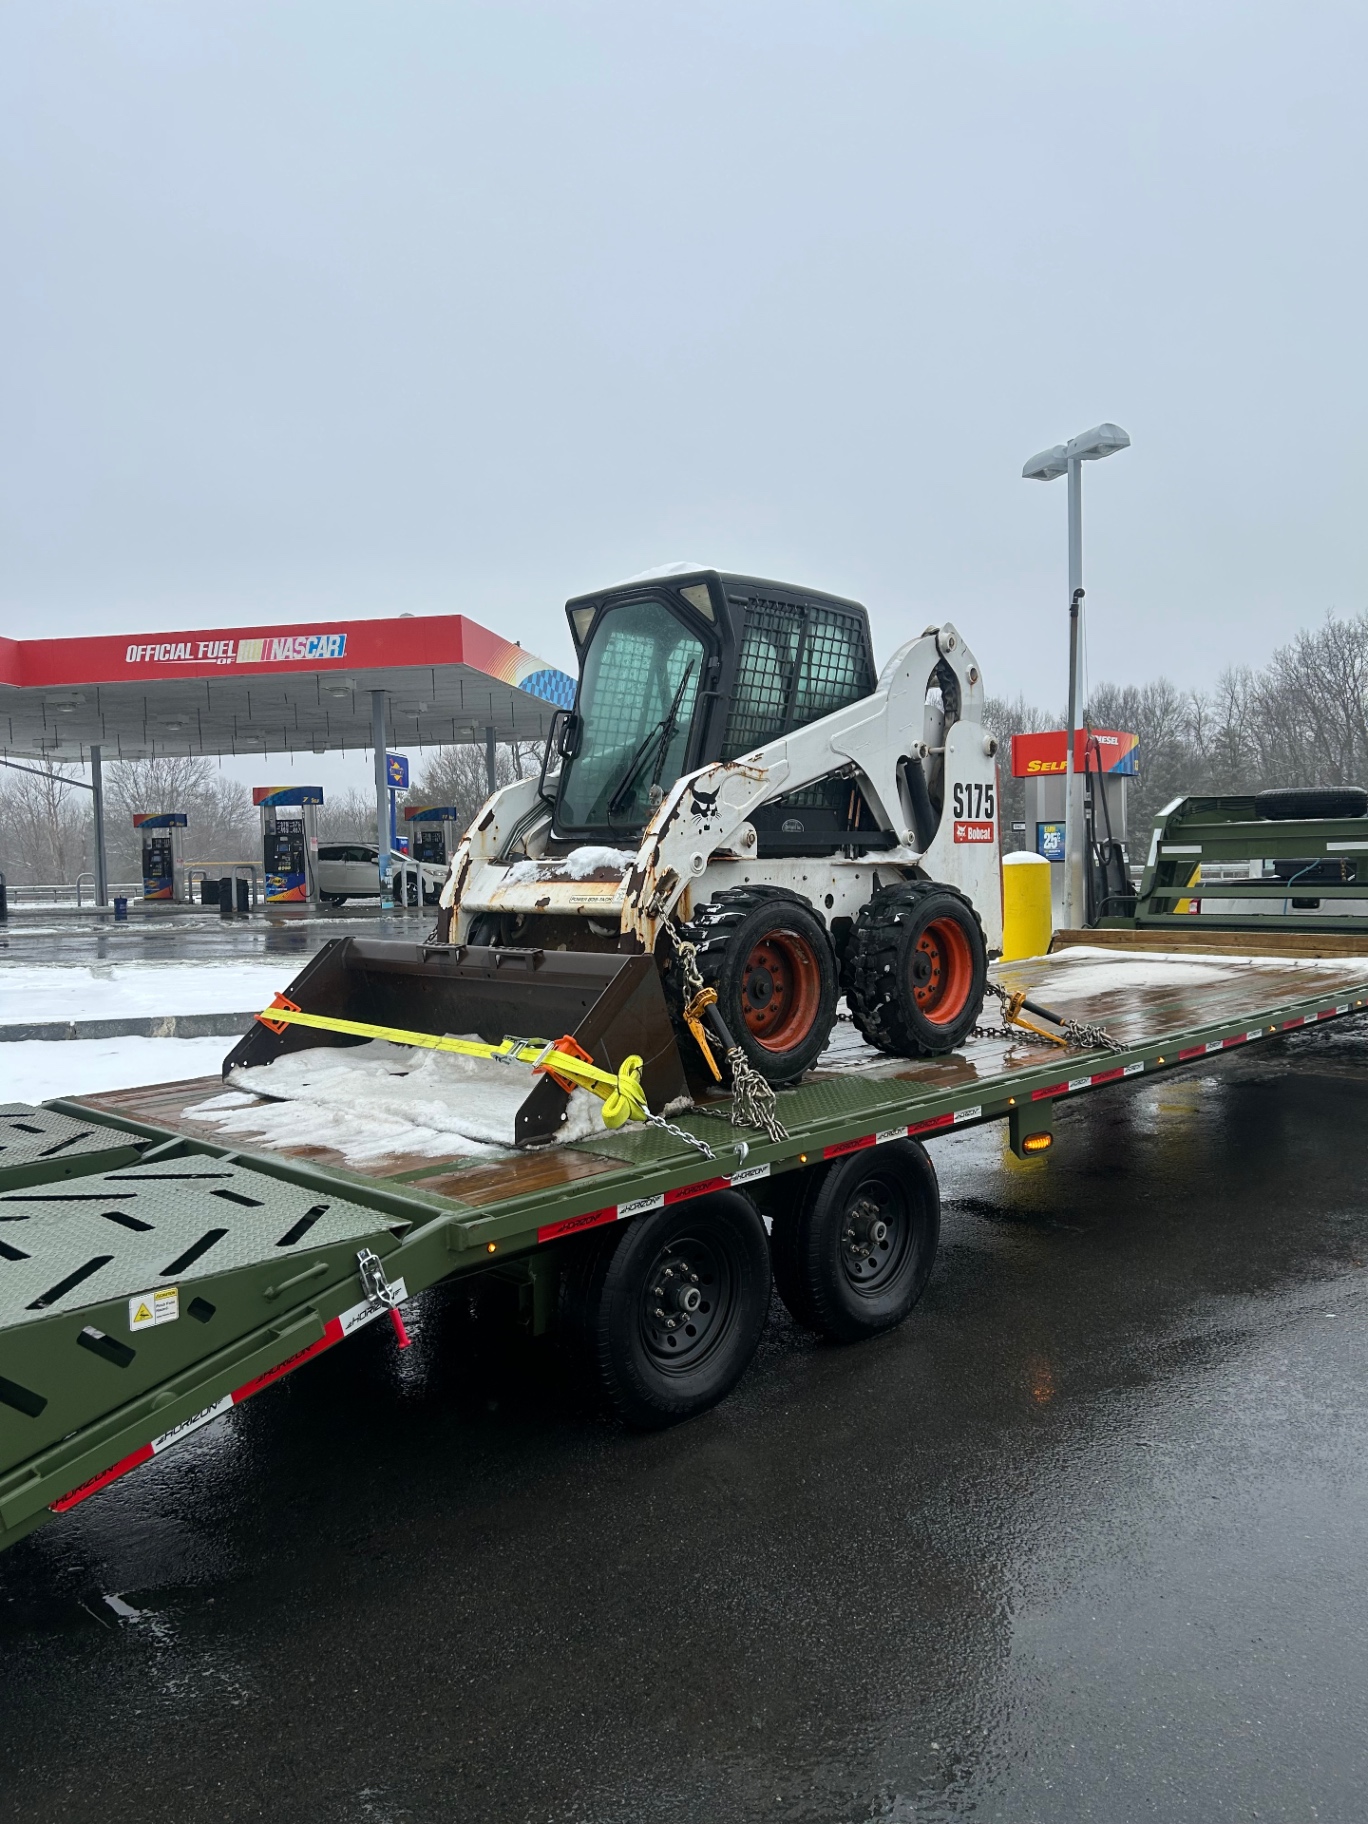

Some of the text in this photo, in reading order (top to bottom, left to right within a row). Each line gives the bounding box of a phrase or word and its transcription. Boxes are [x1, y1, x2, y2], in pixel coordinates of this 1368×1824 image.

[126, 635, 341, 662] OFFICIAL FUEL NASCAR
[954, 783, 994, 819] S175
[968, 827, 991, 840] Bobcat
[735, 1166, 768, 1181] HORIZON
[677, 1182, 713, 1198] HORIZON
[622, 1195, 661, 1213] HORIZON
[560, 1213, 602, 1232] HORIZON
[350, 1288, 401, 1327] HORIZ
[261, 1343, 314, 1381] HORIZON
[160, 1398, 223, 1438] HORIZON
[54, 1461, 119, 1508] HORIZON
